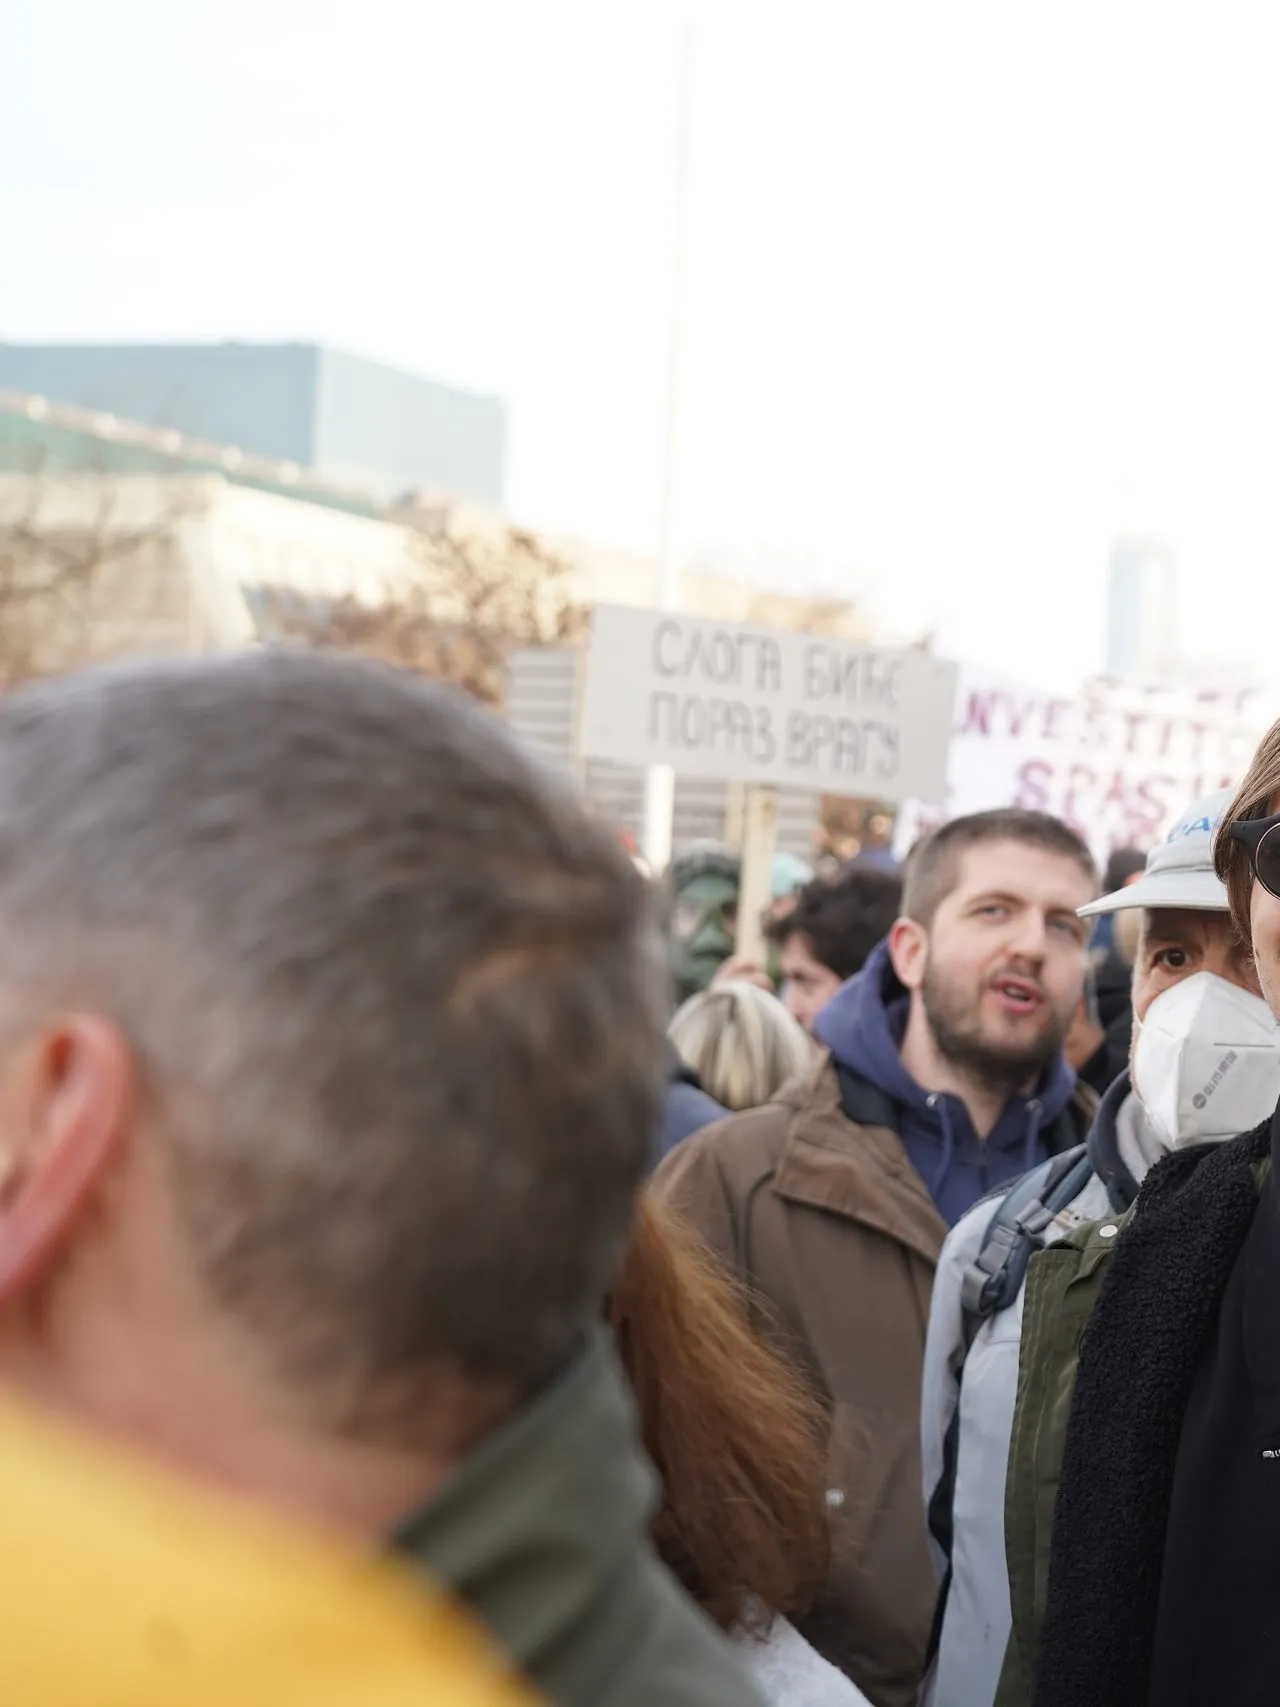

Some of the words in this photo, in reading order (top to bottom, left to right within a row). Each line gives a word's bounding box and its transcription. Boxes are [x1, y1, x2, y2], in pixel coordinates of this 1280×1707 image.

[650, 619, 782, 692] СЛОГА
[646, 689, 778, 766] ПОРАЗ
[785, 710, 900, 780] ВРАГУ
